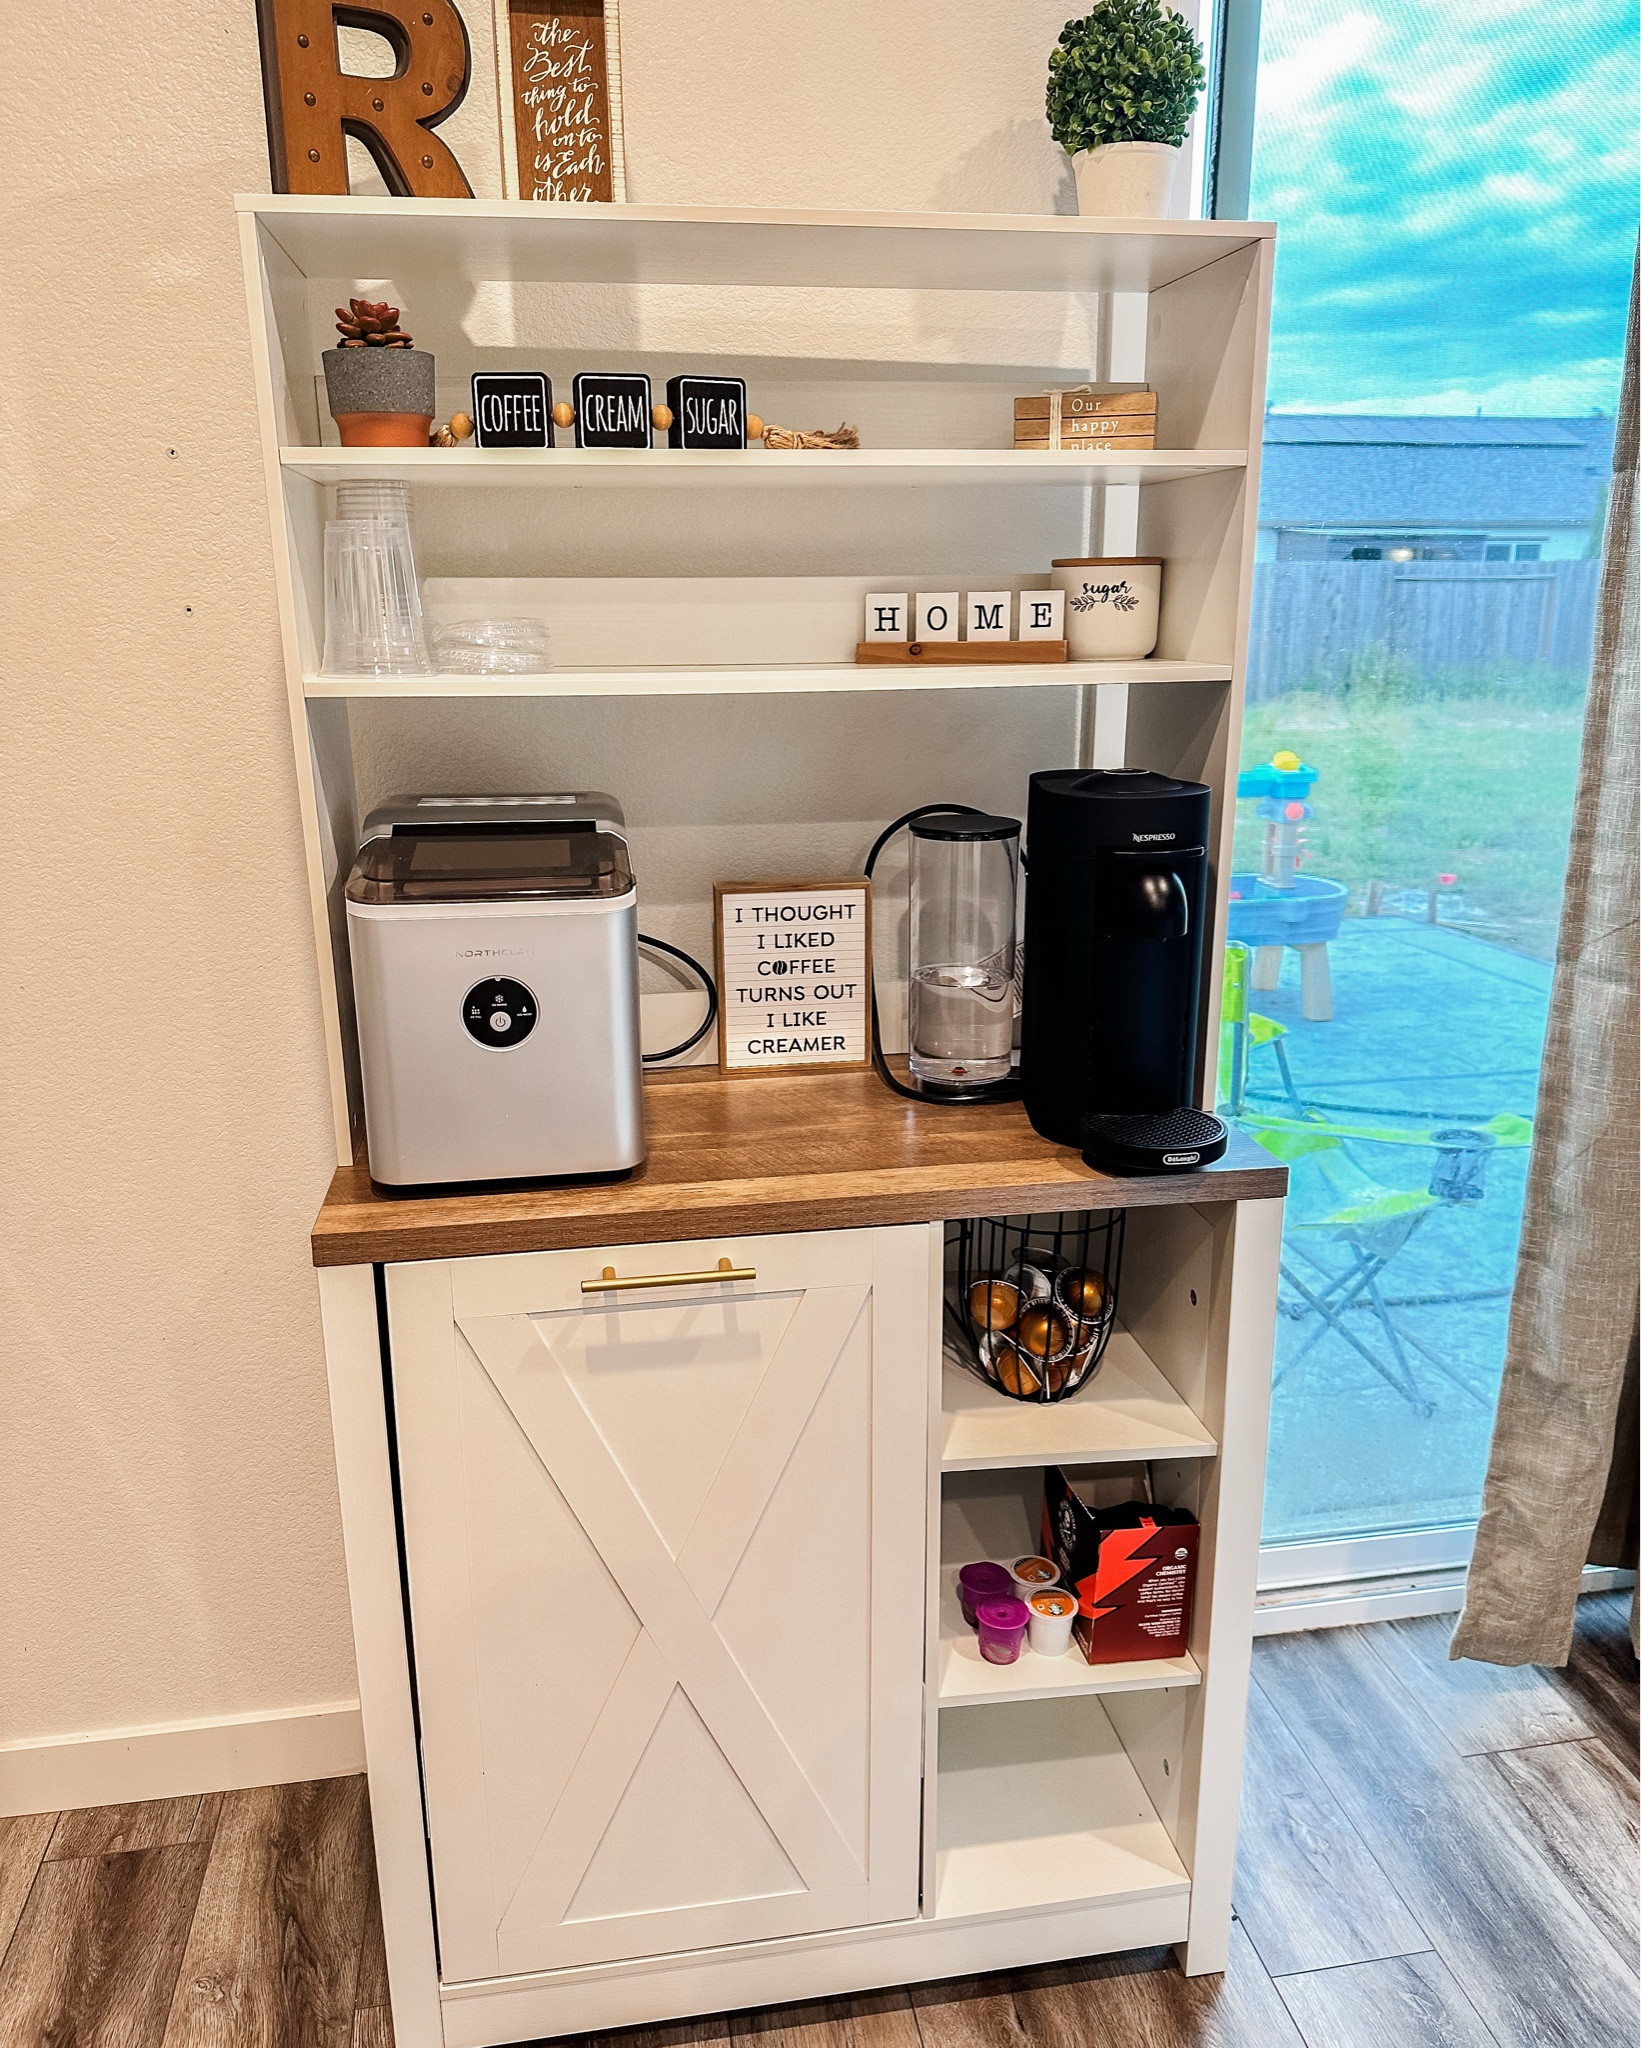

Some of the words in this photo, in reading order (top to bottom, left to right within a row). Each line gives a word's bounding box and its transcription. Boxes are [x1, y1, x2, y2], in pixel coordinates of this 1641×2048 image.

[531, 17, 580, 46] the
[523, 38, 595, 82] Best
[521, 84, 567, 113] thing
[568, 77, 599, 93] to
[531, 93, 600, 142] hold
[553, 131, 577, 147] on
[575, 127, 603, 147] to
[534, 150, 556, 172] is
[552, 143, 606, 179] Each
[481, 393, 543, 433] COFFEE
[585, 394, 646, 434] CREAM
[686, 396, 740, 437] SUGAR
[1071, 398, 1102, 412] Our
[1071, 418, 1120, 435] happy
[1082, 580, 1132, 604] sugar
[735, 908, 743, 923] I
[752, 904, 856, 923] THOUGHT
[757, 934, 765, 949] I
[774, 932, 835, 949] LIKED
[736, 986, 806, 1003] TURNS
[813, 984, 858, 1000] OUT
[766, 1013, 775, 1028] I
[783, 1011, 828, 1027] LIKE
[747, 1036, 846, 1055] CREAMER
